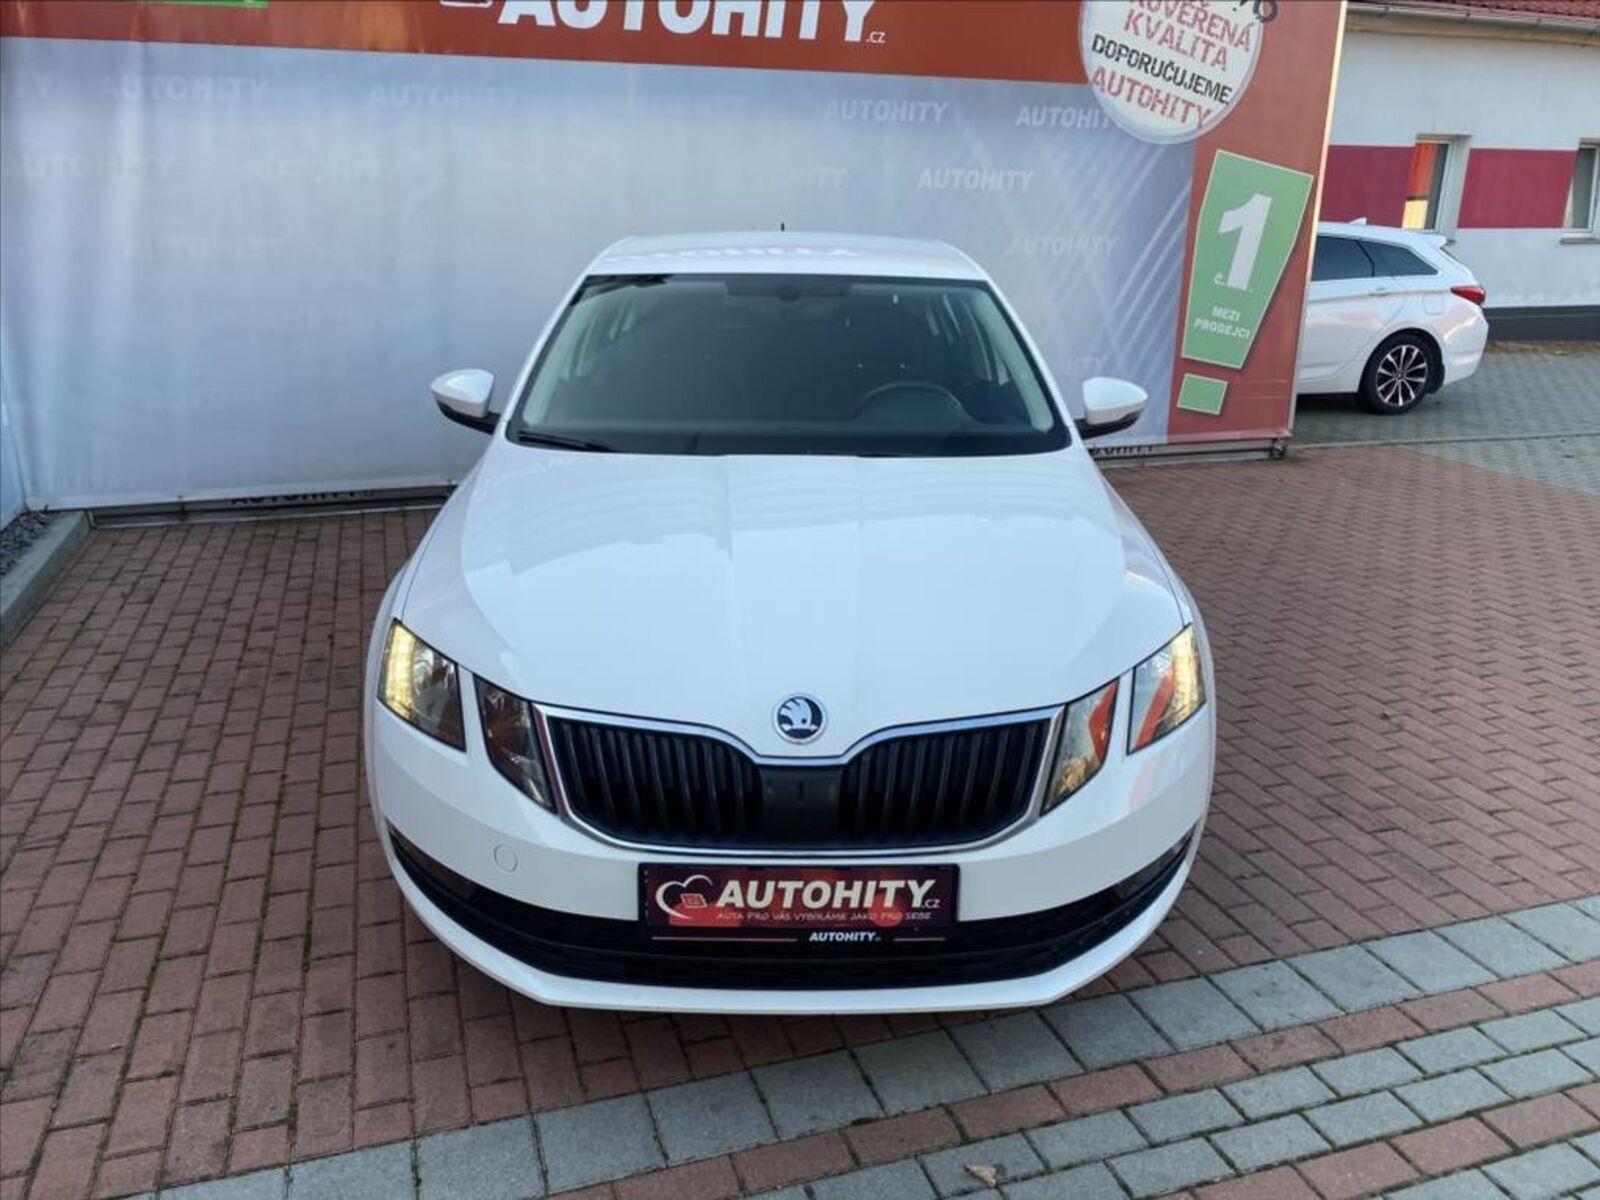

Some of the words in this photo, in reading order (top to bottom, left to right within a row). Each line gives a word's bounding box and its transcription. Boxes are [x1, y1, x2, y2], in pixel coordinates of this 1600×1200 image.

[1124, 9, 1228, 71] KVALITA
[1092, 33, 1232, 106] DOPORUČUJEME
[825, 98, 949, 124] AUTOHITY
[1092, 66, 1212, 130] AUTOHITY
[917, 167, 1035, 192] AUTOHITY
[1211, 305, 1241, 322] MEZI
[1194, 317, 1250, 340] PRODEJCI
[715, 879, 936, 909] AUTOHITY
[809, 931, 876, 942] AUTOHITY
